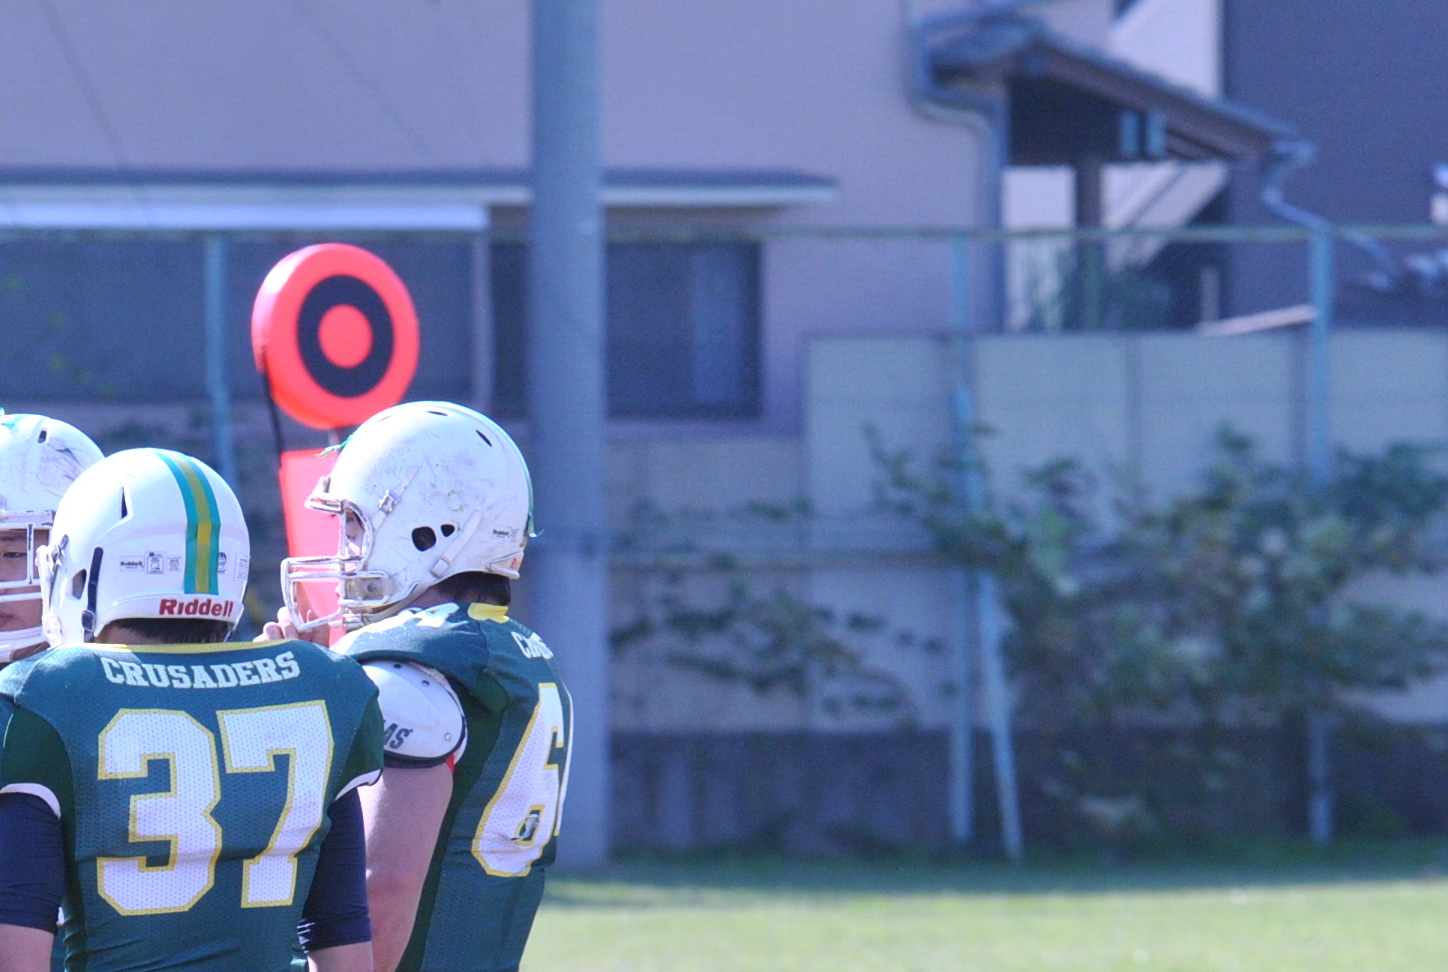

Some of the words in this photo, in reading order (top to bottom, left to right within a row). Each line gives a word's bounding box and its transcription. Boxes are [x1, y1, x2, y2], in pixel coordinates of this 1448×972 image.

[158, 598, 234, 617] Riddell
[100, 651, 301, 689] CRUSADERS
[96, 699, 334, 917] 37
